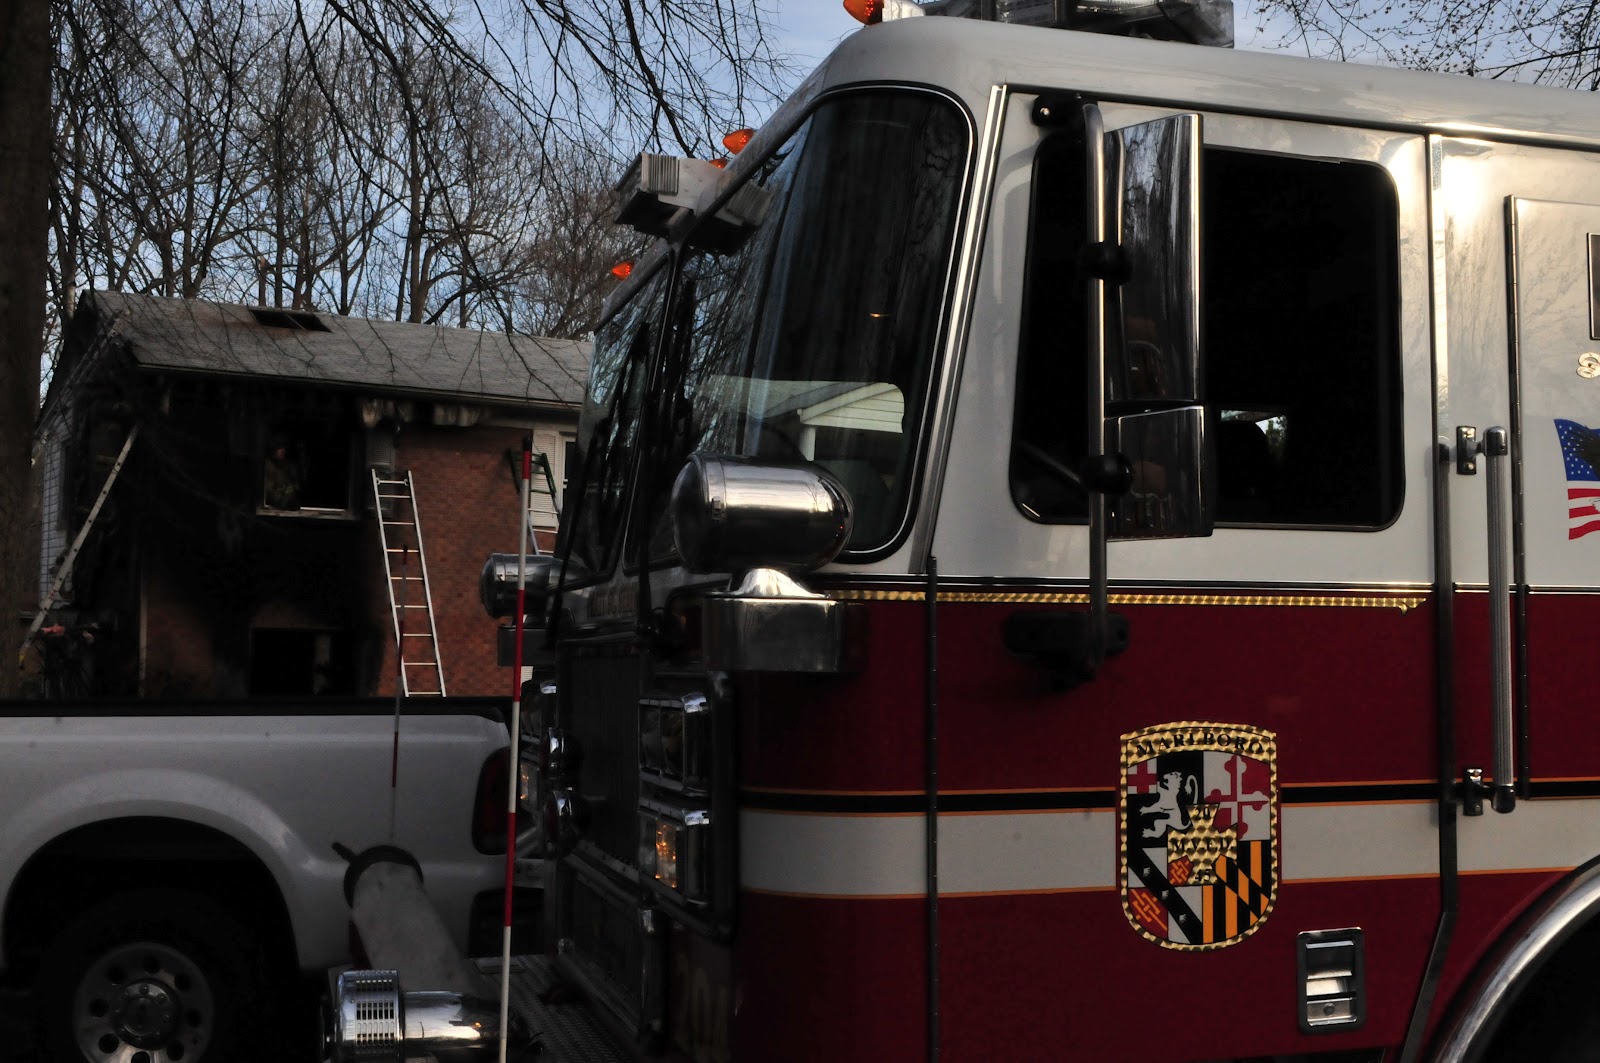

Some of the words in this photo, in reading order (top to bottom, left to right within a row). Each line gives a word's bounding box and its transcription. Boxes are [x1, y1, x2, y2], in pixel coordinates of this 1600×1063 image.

[1135, 732, 1262, 758] MARLBORO
[1193, 806, 1211, 820] 20
[1194, 868, 1211, 881] 45
